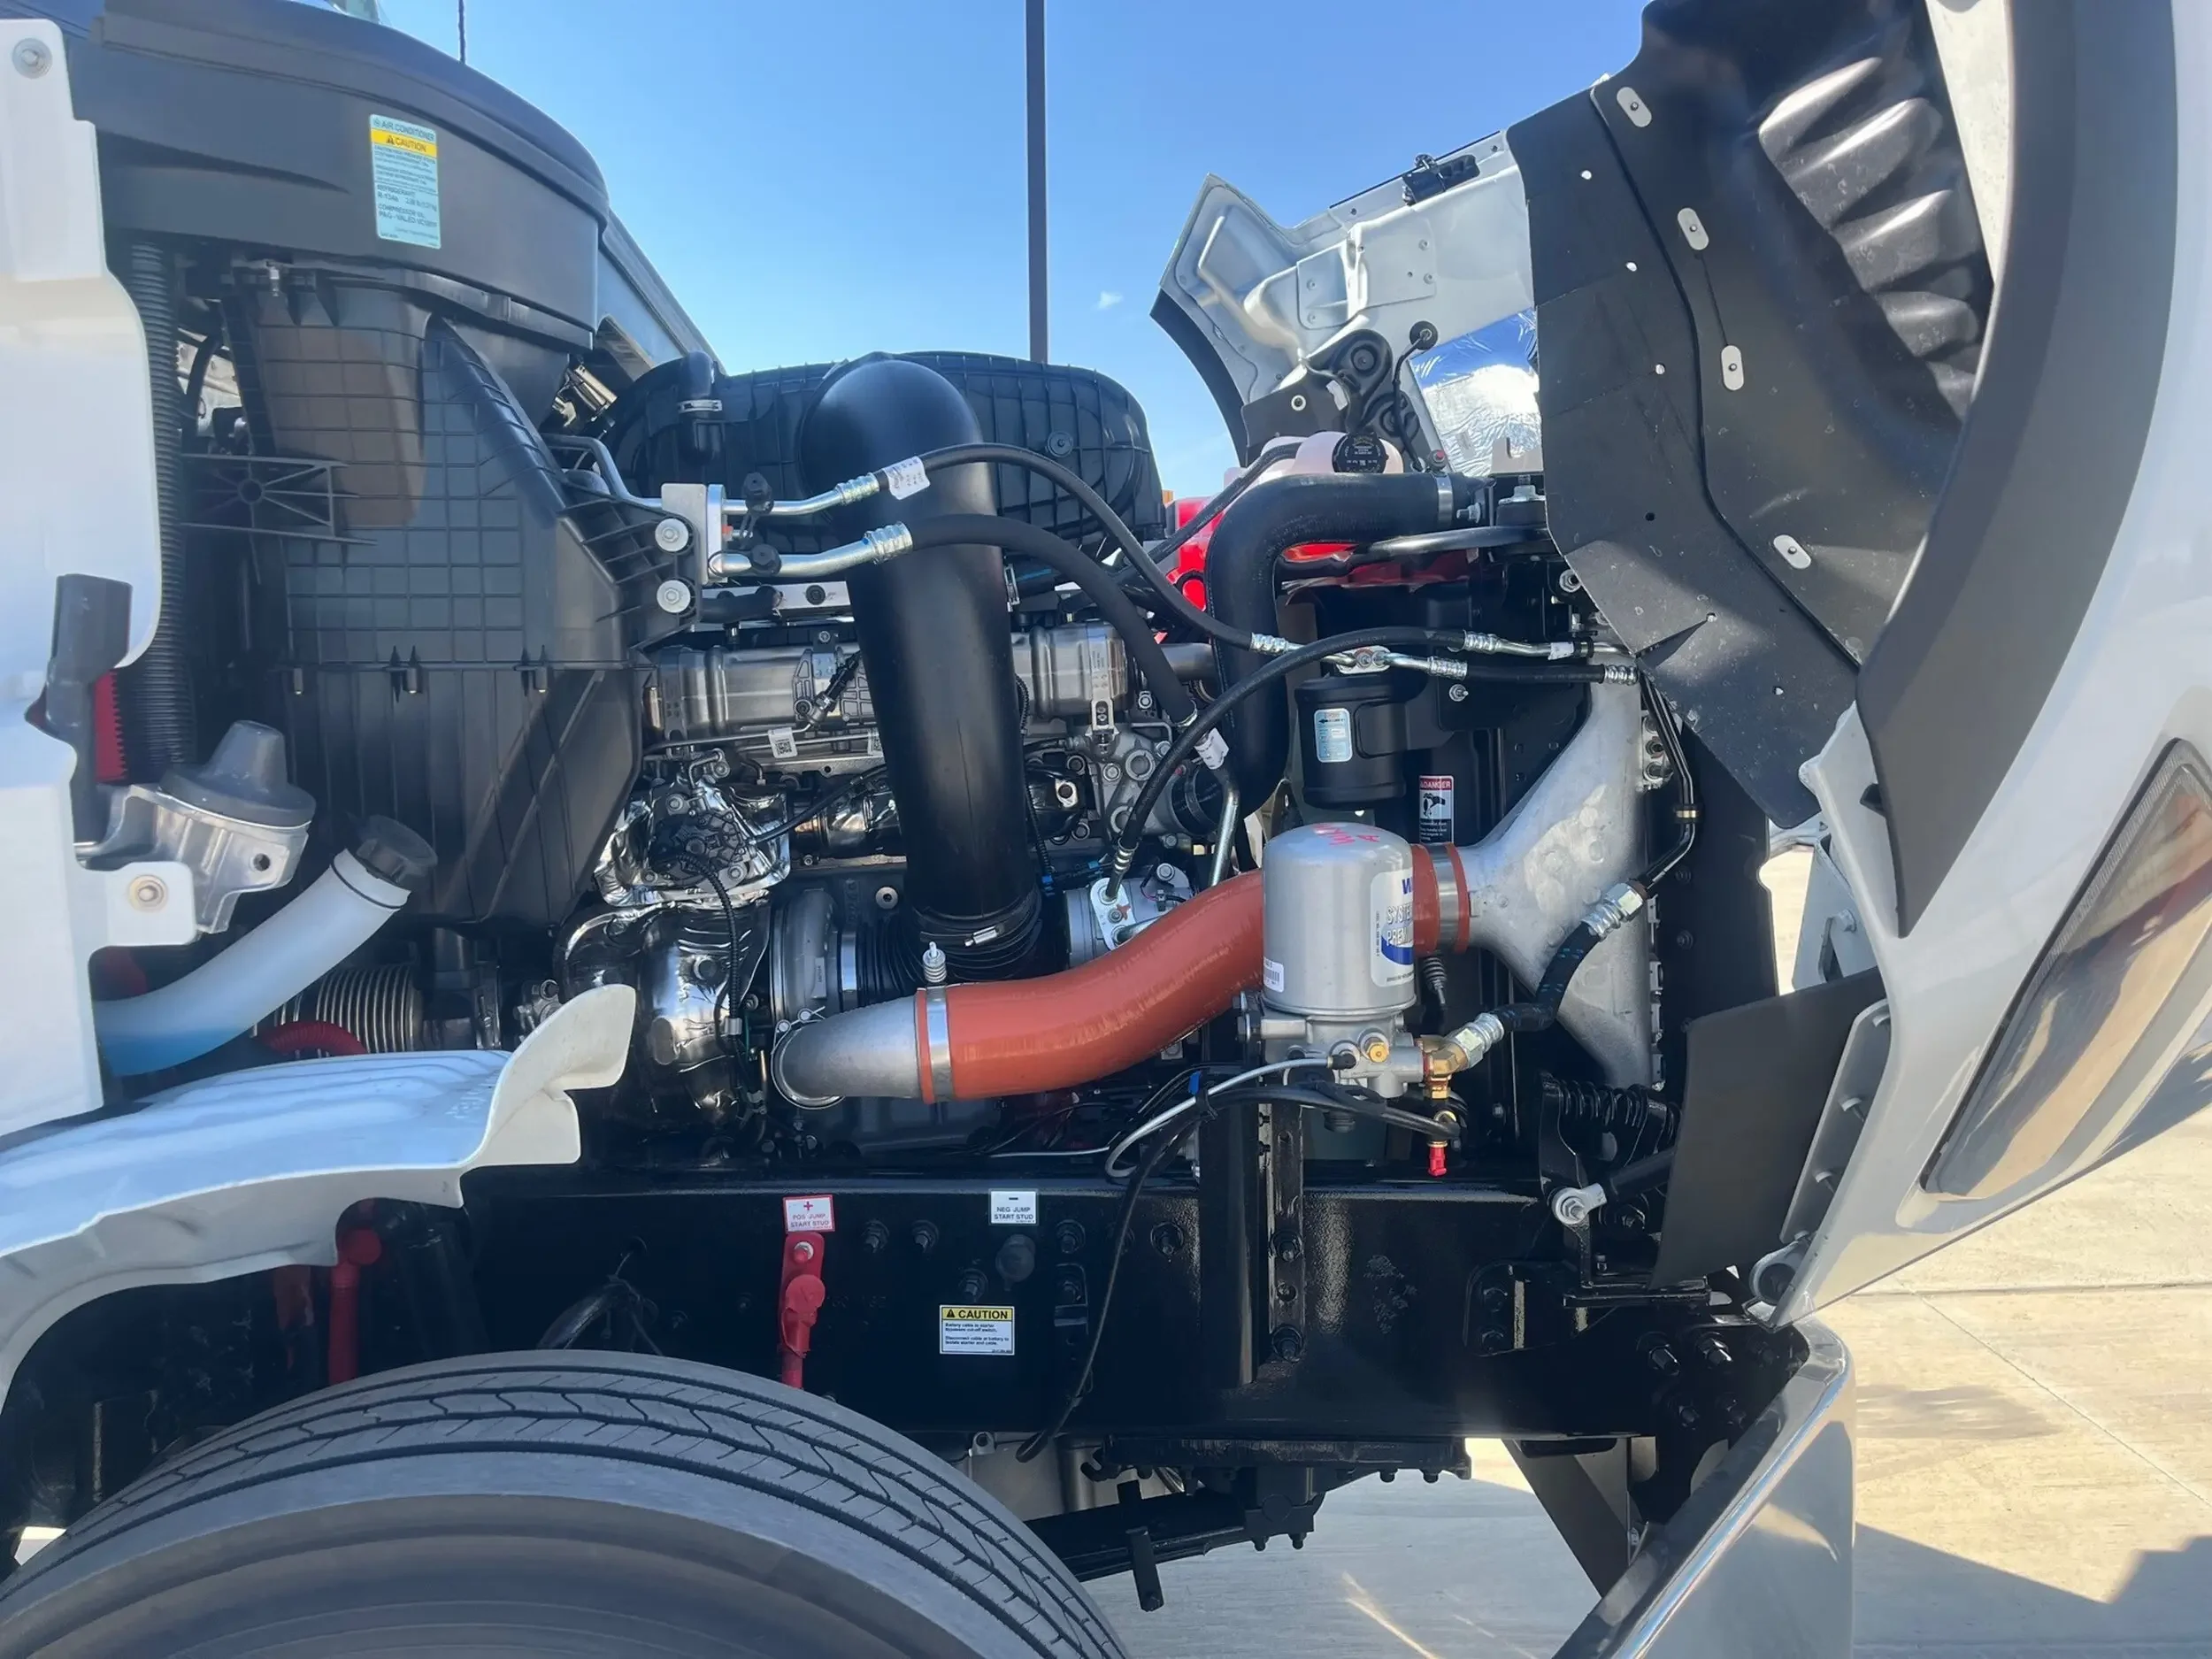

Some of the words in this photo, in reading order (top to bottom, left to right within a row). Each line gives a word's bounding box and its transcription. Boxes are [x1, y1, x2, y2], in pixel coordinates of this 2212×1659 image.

[381, 119, 394, 129] AIR
[395, 124, 434, 141] CONDITIONER
[395, 137, 426, 153] CAUTION
[1402, 877, 1413, 895] W
[1386, 902, 1413, 925] SYSTE
[958, 1310, 1008, 1319] CAUTION
